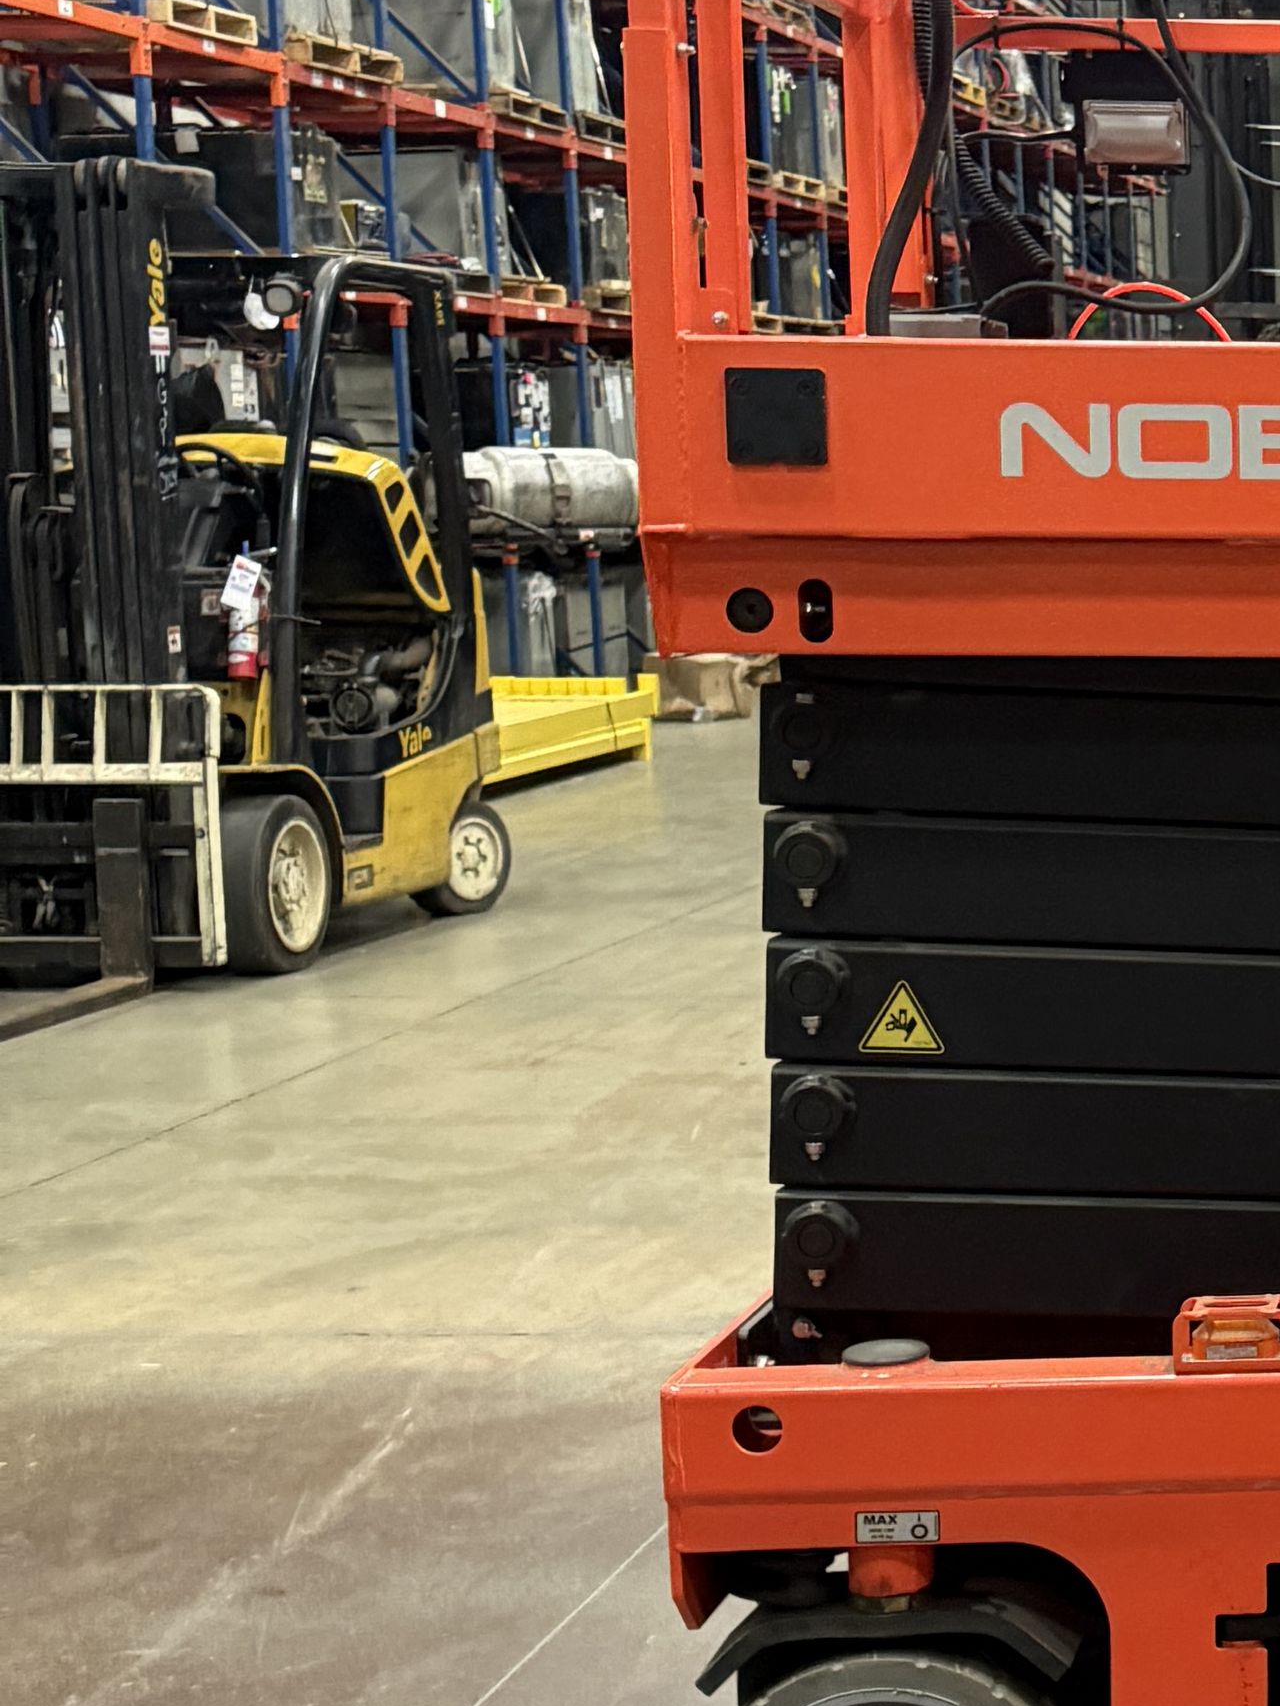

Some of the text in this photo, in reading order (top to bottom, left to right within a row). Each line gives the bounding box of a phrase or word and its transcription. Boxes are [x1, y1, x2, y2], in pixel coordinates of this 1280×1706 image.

[147, 237, 166, 327] Yale
[398, 722, 433, 758] Yale
[863, 1514, 898, 1525] MAX
